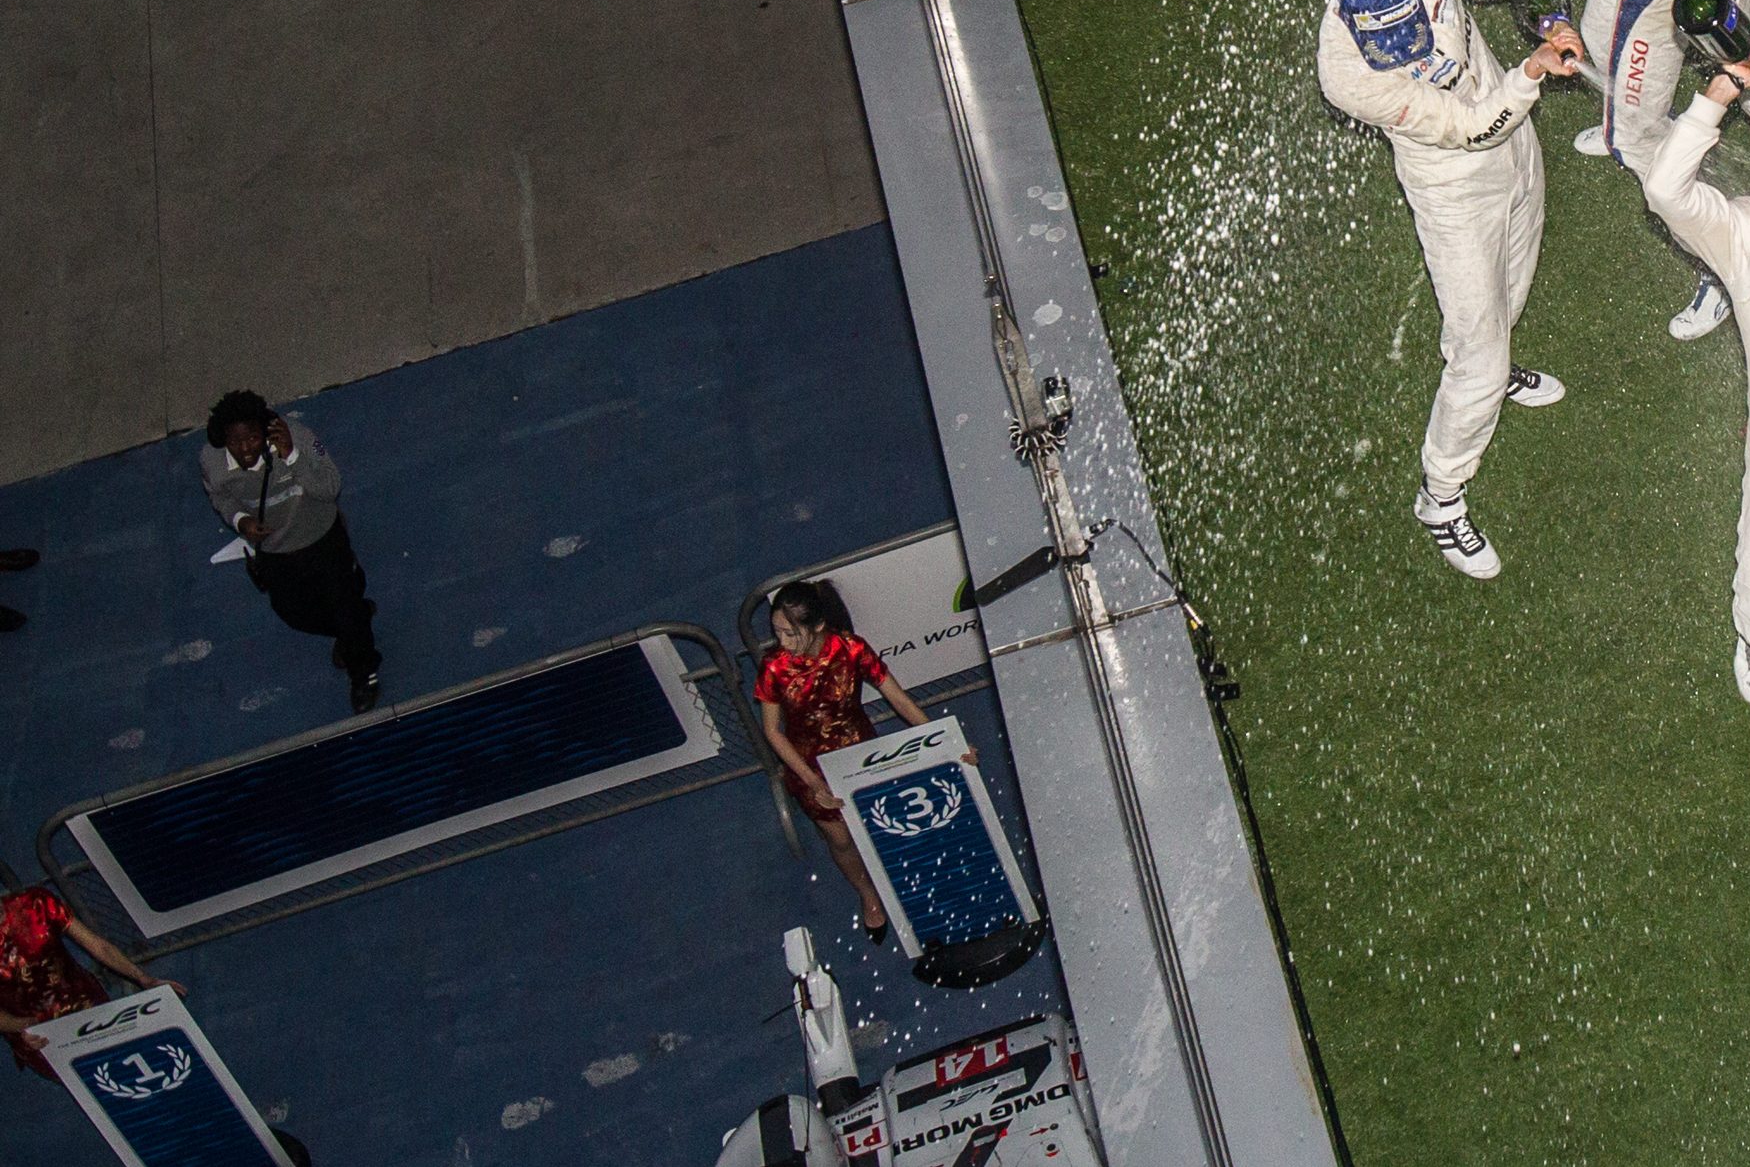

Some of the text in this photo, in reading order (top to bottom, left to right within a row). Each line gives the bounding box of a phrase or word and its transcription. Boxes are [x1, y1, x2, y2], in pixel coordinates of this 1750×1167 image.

[1625, 40, 1649, 106] DENSO
[879, 619, 981, 661] FIA WOR
[861, 730, 945, 768] WEC
[898, 787, 934, 820] 3
[76, 997, 162, 1037] WEC
[122, 1052, 165, 1083] 1
[939, 1037, 1008, 1080] 14
[989, 1083, 1070, 1122] DMG
[847, 1127, 882, 1151] P1
